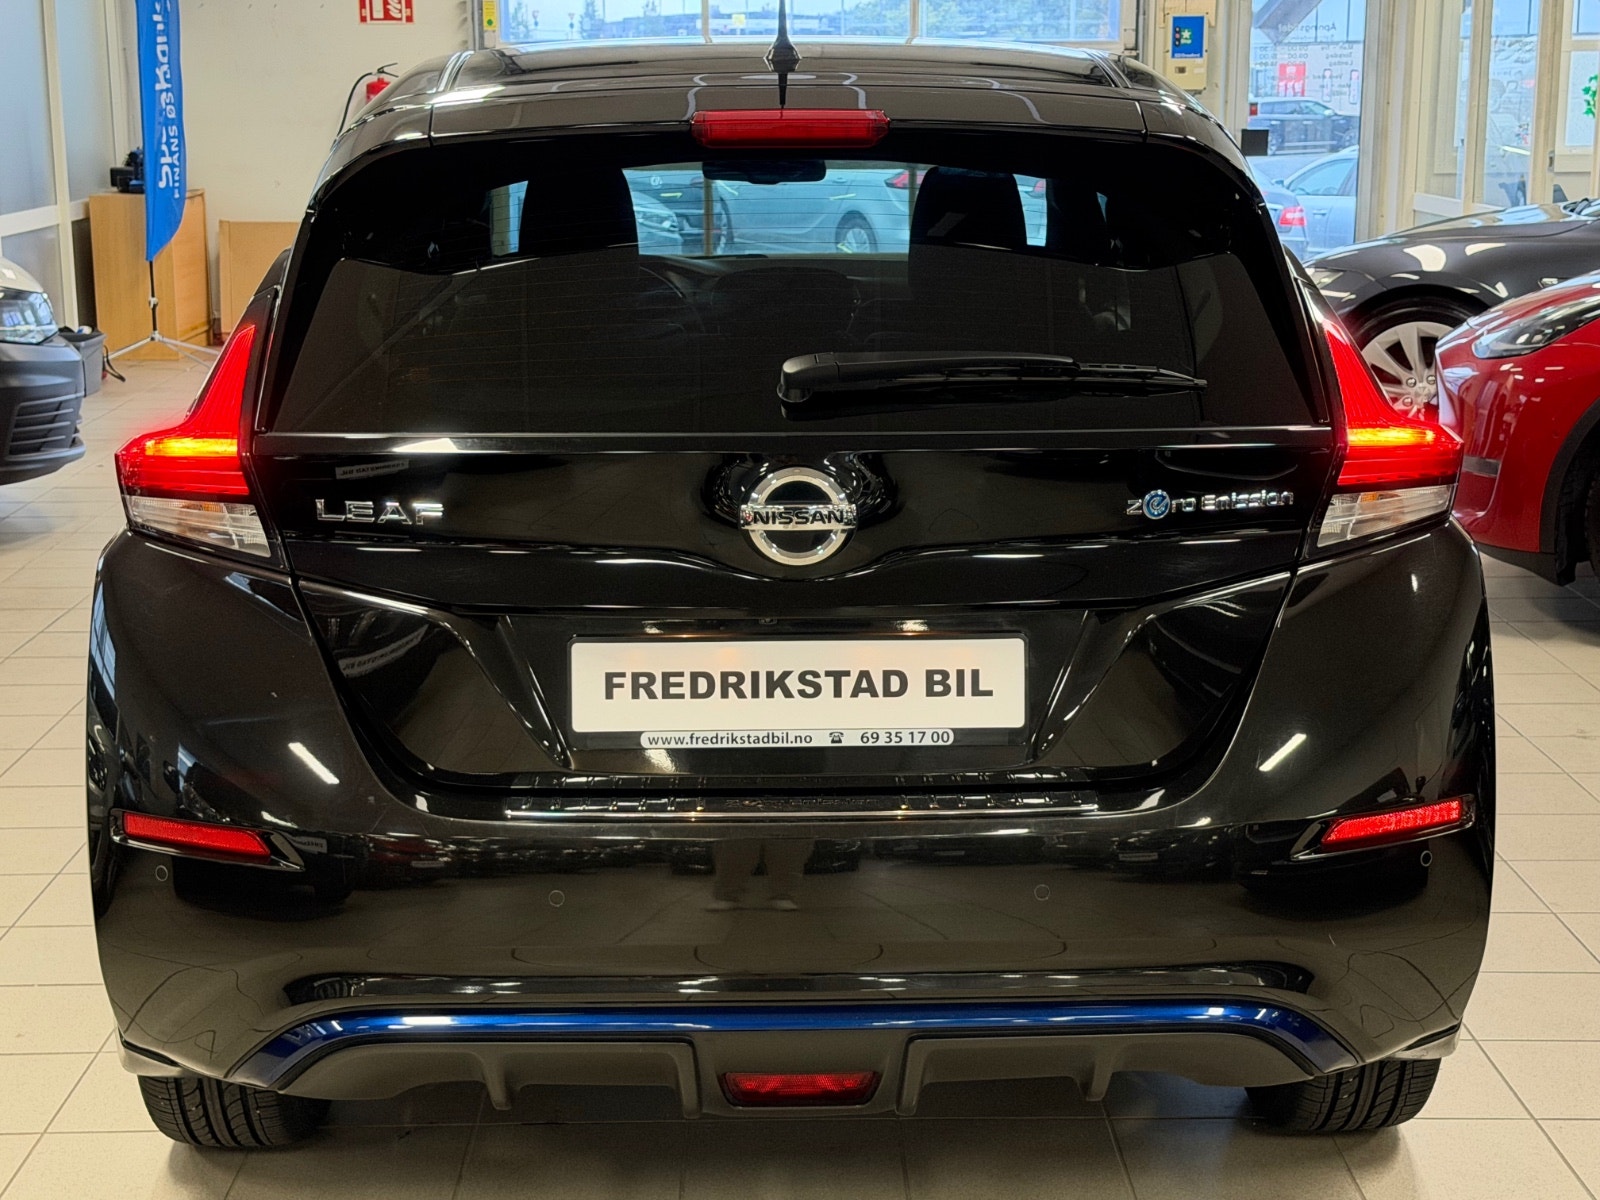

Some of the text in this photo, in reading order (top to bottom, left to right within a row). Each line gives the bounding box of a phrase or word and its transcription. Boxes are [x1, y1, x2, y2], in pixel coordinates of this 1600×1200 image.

[315, 498, 445, 526] LEAF
[753, 509, 846, 525] NISSAN
[603, 668, 994, 701] FREDRIKSTAD BIL
[647, 731, 951, 746] www.fredrikstadbil.no 69 35 17 00
